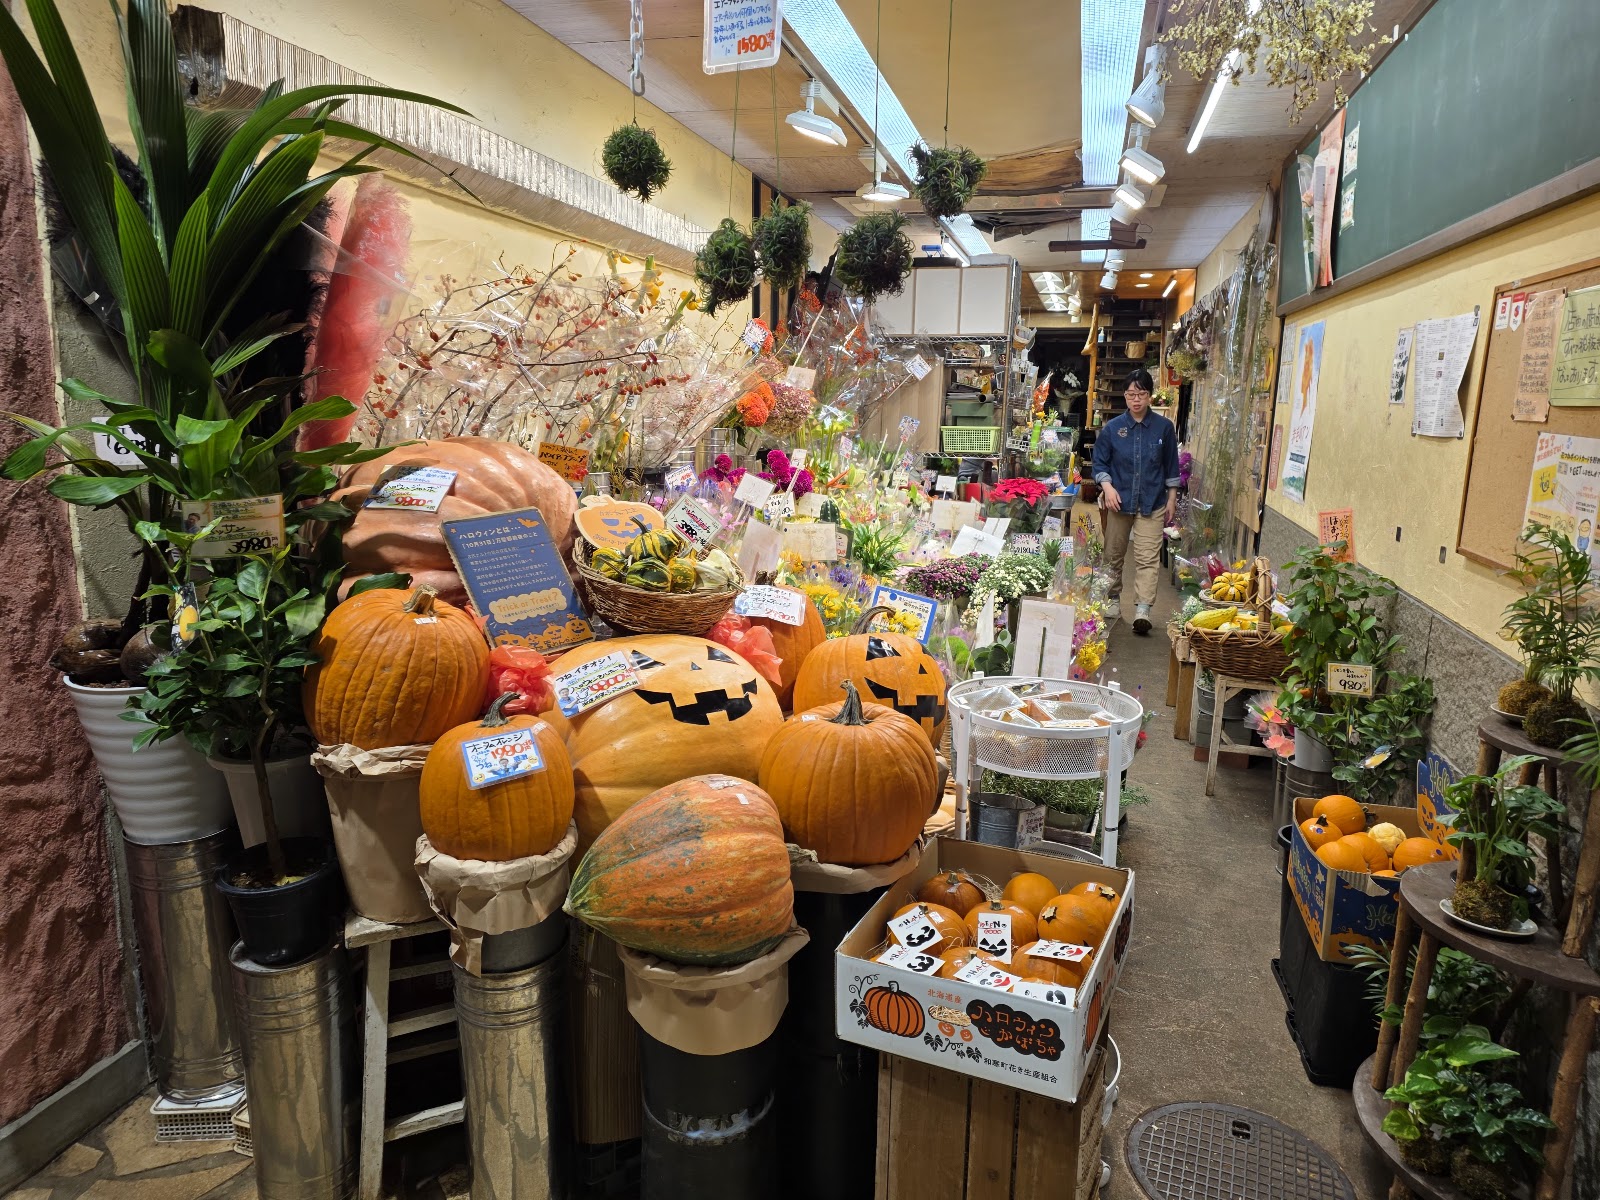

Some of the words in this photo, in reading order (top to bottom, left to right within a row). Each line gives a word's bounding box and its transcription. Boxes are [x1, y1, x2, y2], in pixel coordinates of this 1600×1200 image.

[497, 602, 519, 613] Trick
[530, 591, 558, 605] Treat?
[927, 988, 963, 1005] 北海道産
[970, 1005, 1054, 1038] ハロウィン
[997, 1028, 1057, 1056] かぼちゃ
[983, 1058, 1058, 1084] 和寒町花き生産組合
